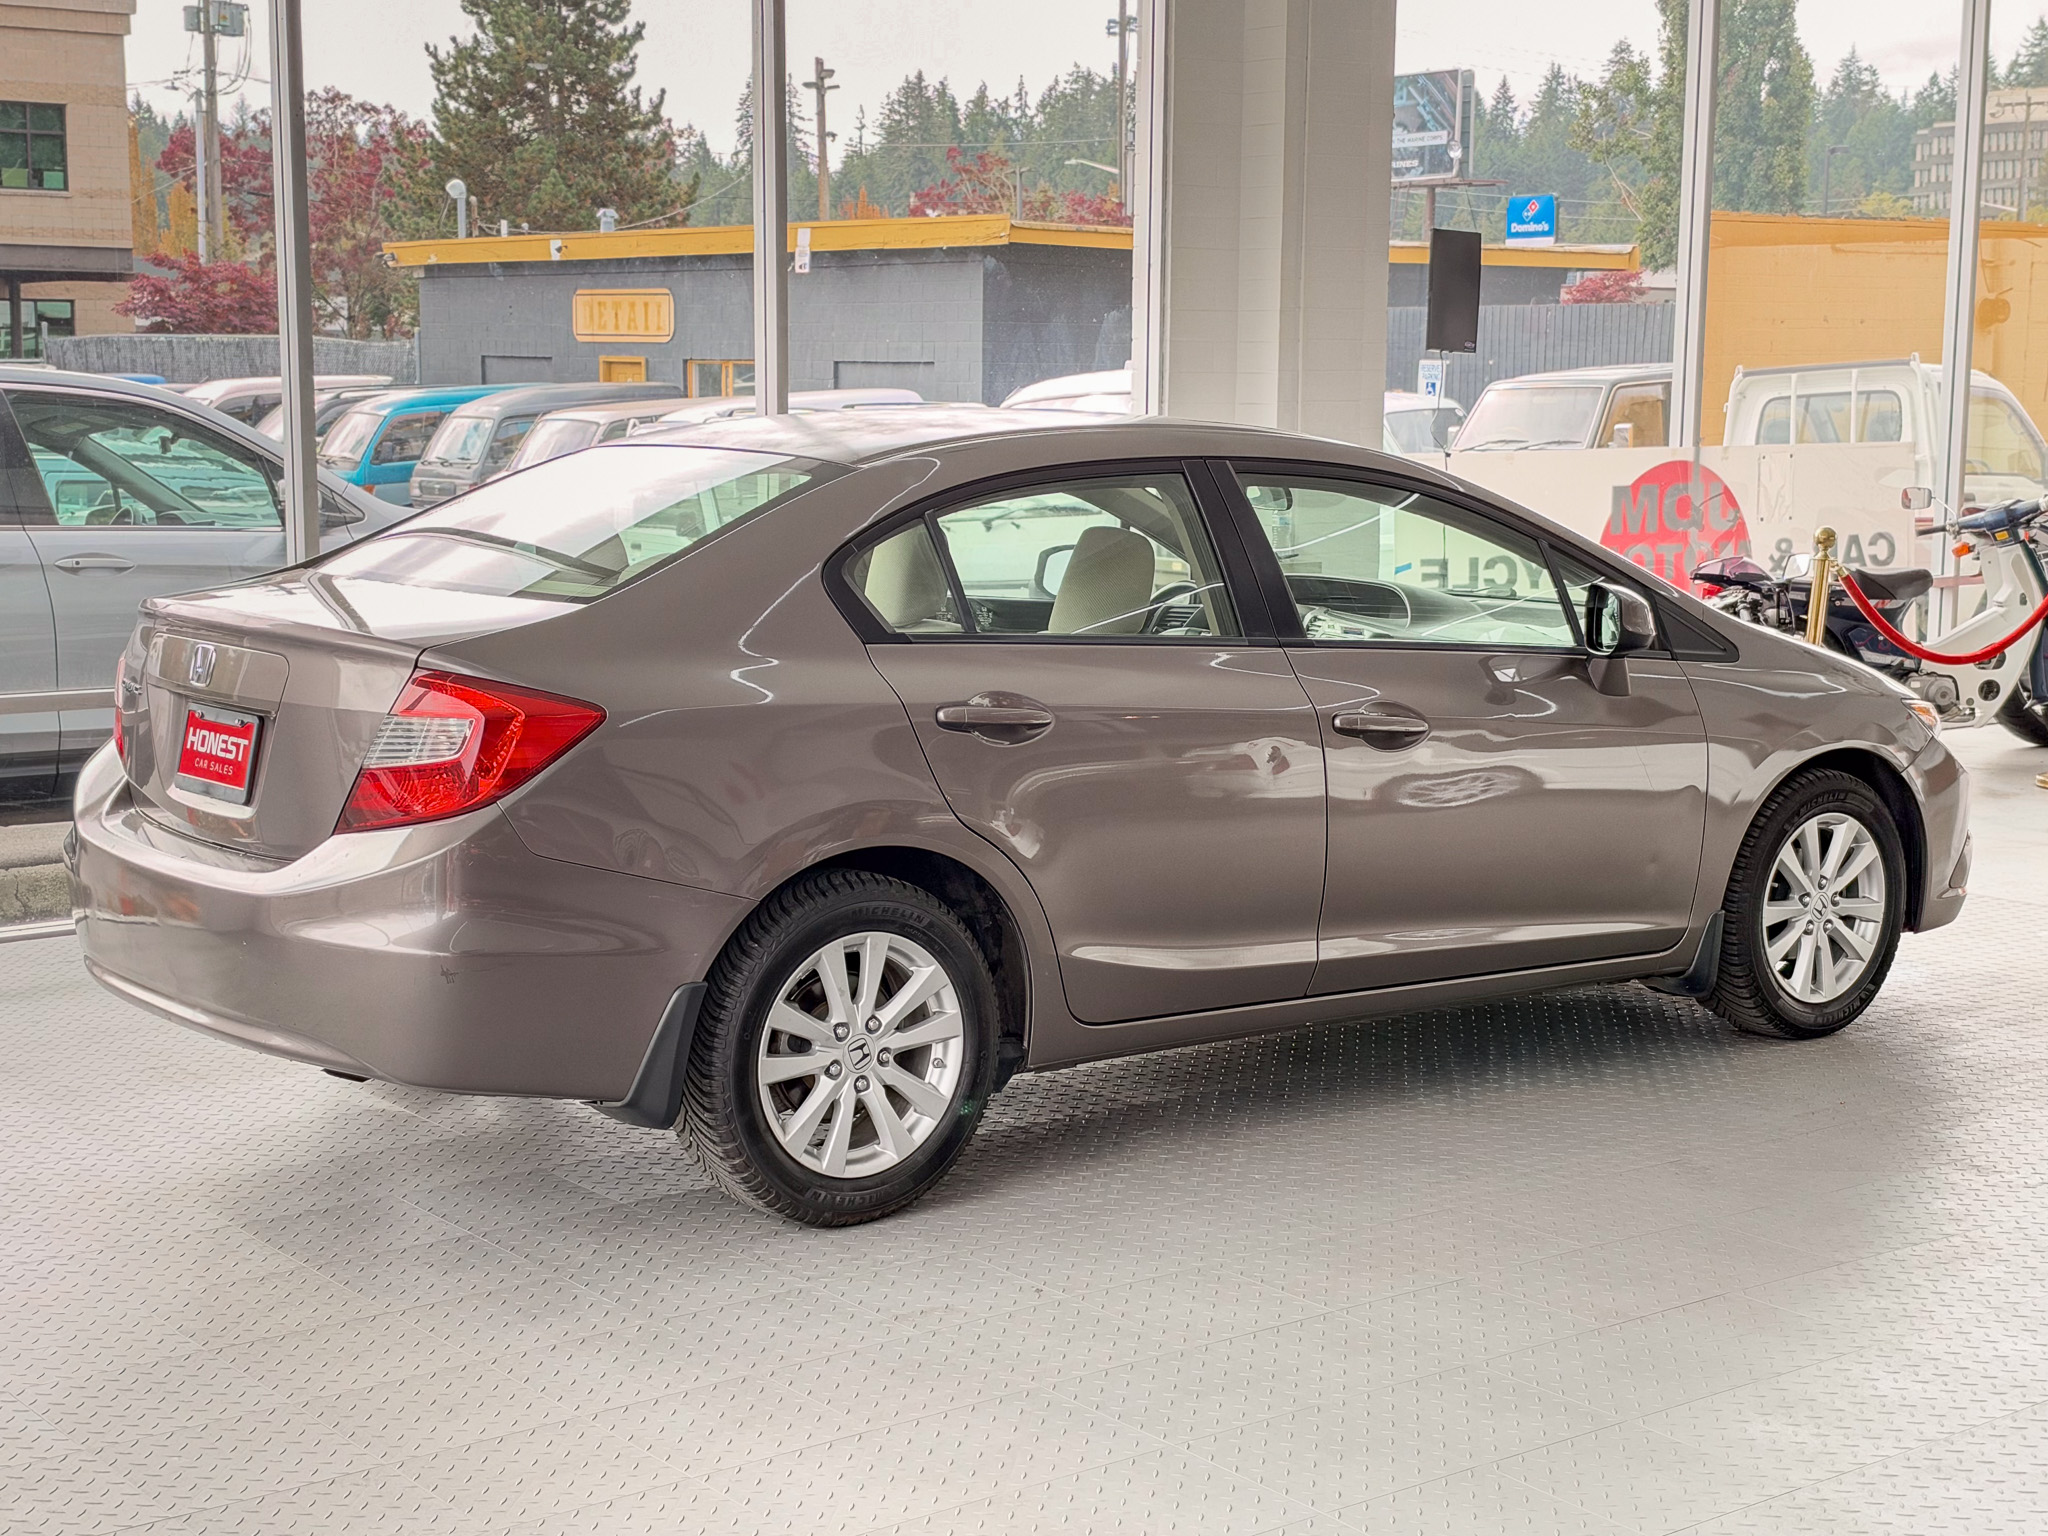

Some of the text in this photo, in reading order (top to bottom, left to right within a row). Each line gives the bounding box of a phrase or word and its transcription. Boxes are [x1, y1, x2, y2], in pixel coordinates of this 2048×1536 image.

[1511, 221, 1549, 233] Domino's
[583, 300, 664, 331] DETAIL
[186, 727, 248, 762] HONEST
[195, 757, 233, 776] CAR SALES
